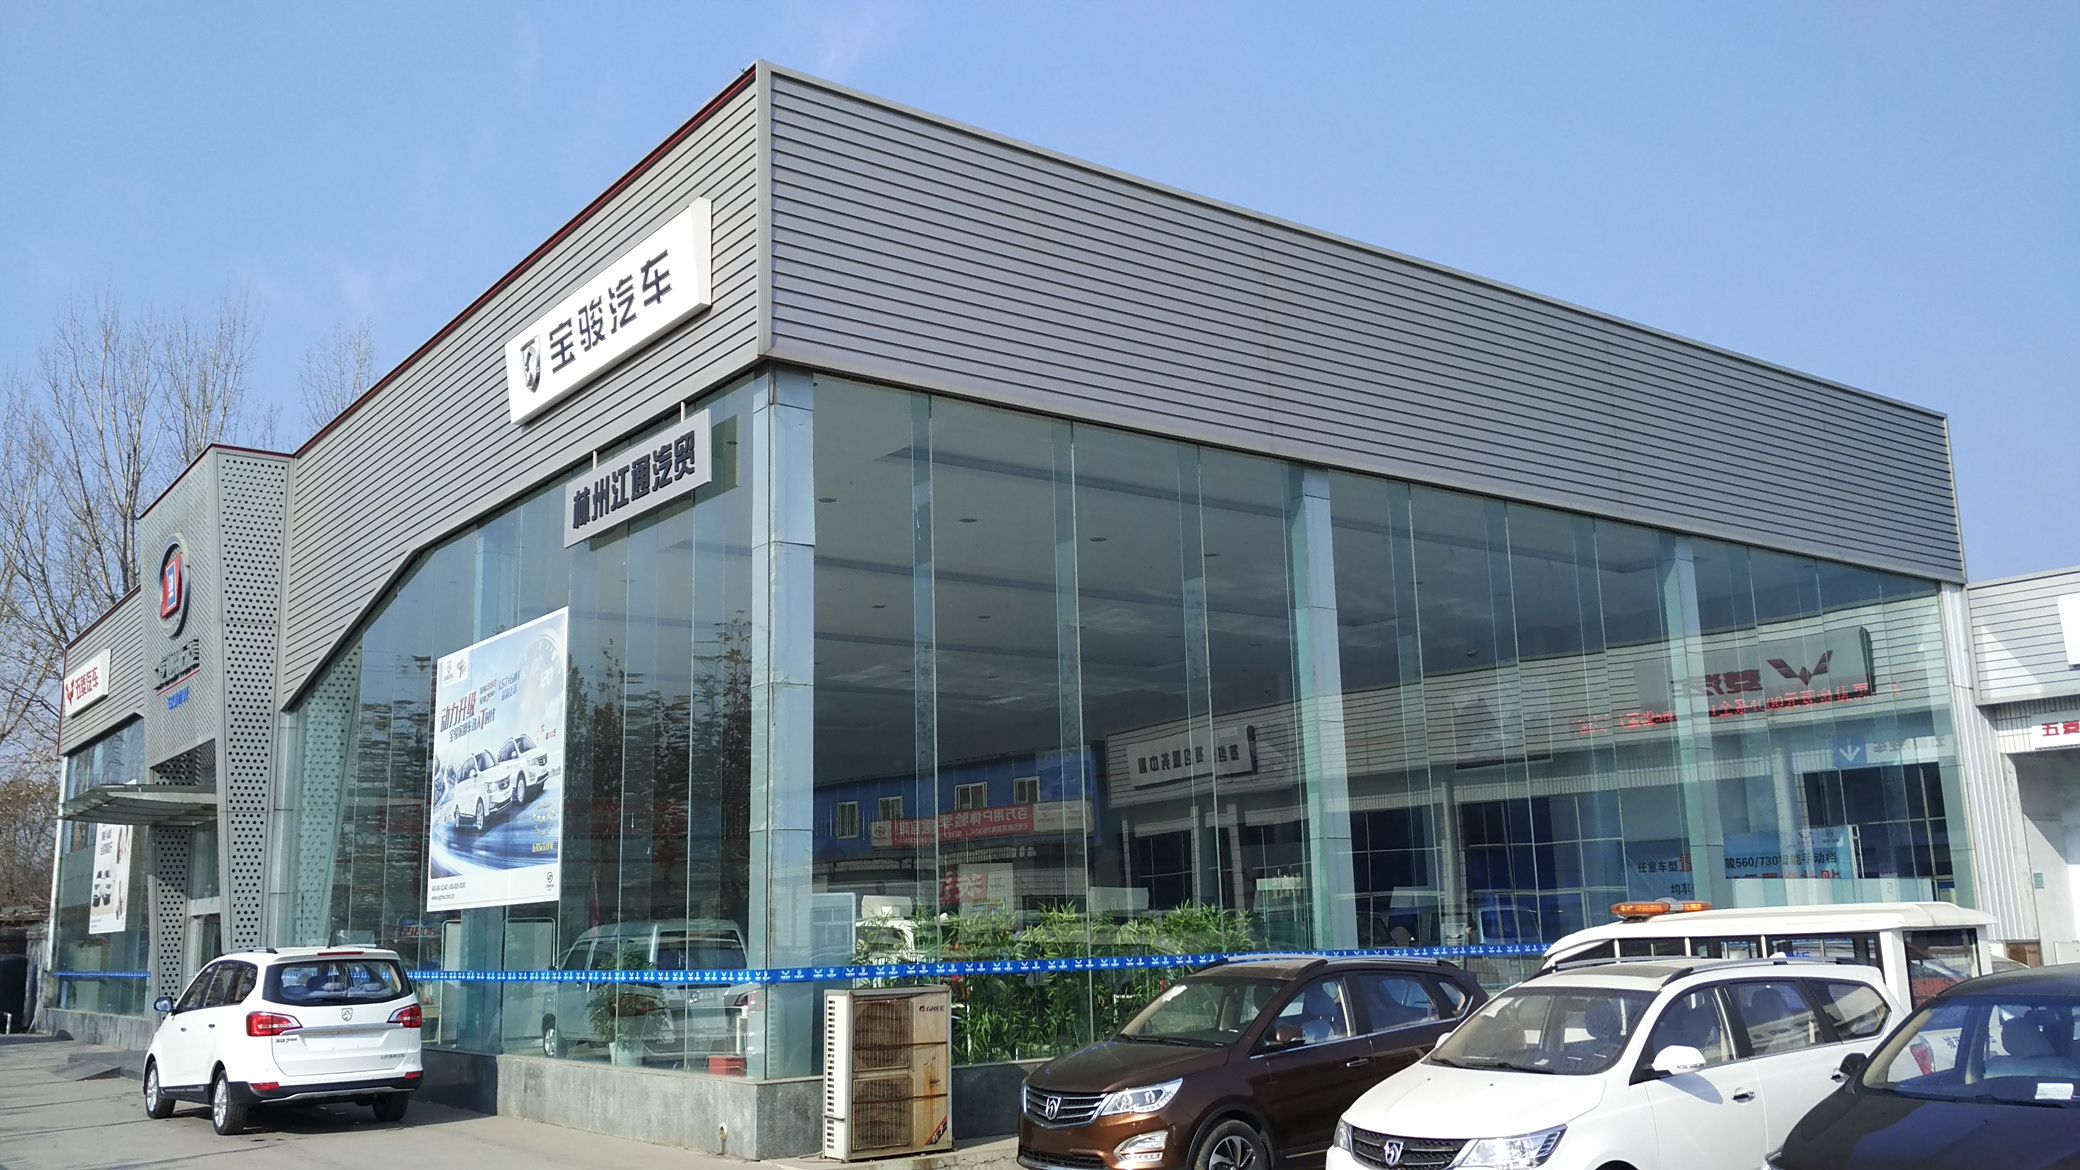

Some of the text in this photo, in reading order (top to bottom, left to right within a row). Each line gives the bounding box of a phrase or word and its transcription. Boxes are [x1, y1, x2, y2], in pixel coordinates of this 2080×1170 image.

[549, 249, 672, 374] 宝骏汽车
[573, 430, 695, 529] 林州江通汽贸
[75, 666, 99, 700] 五菱汽车
[440, 691, 476, 732] 动力升级
[2041, 720, 2080, 737] 五菱
